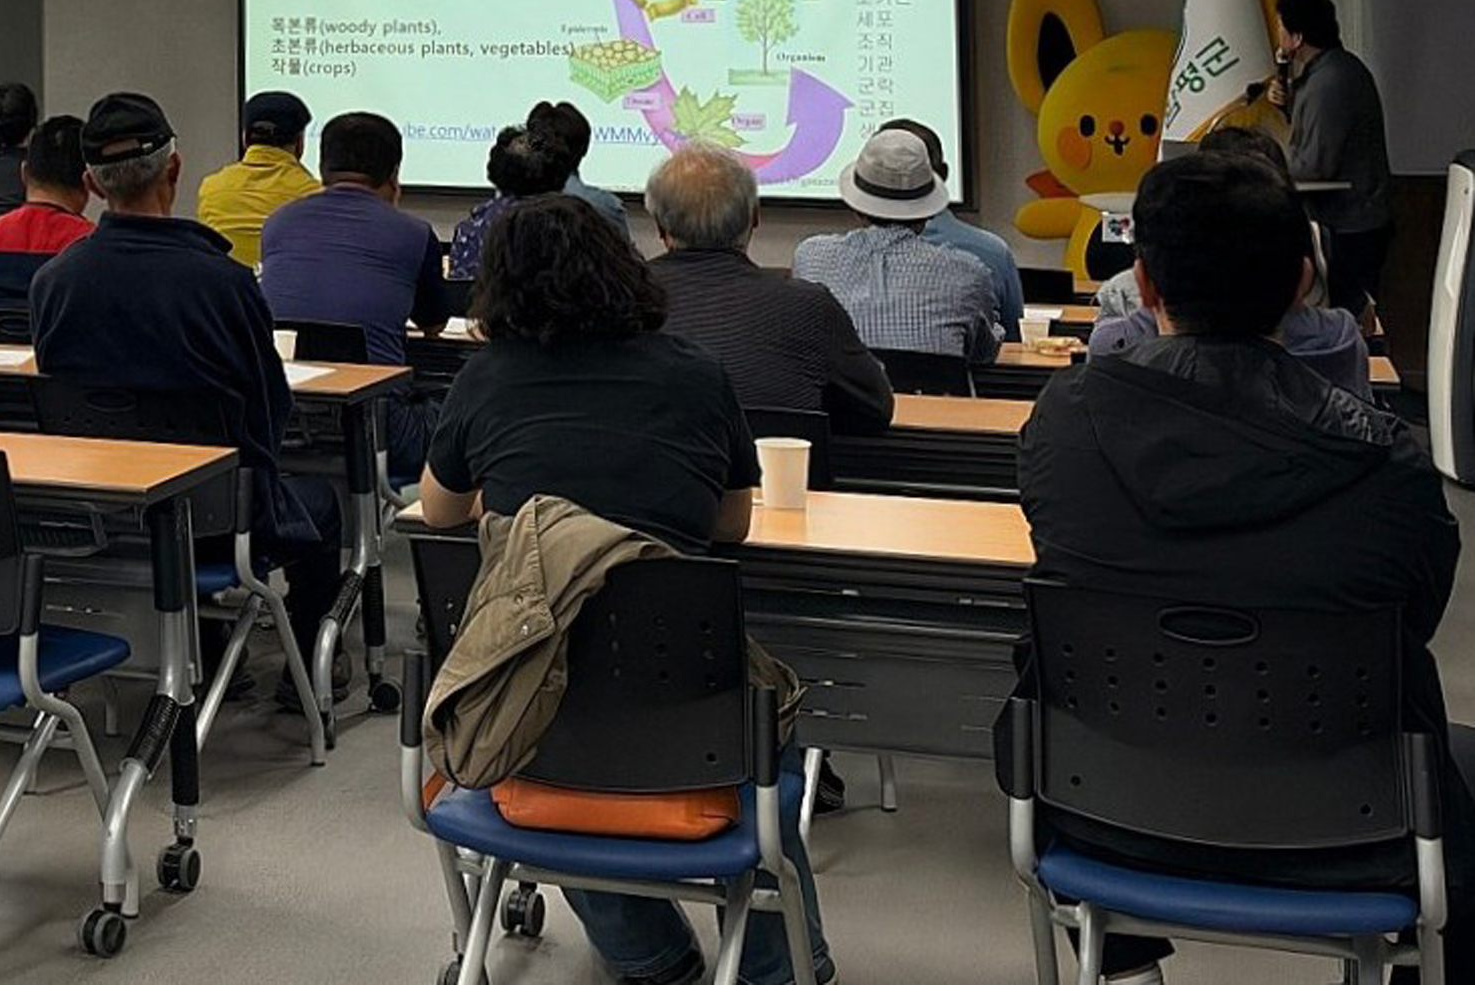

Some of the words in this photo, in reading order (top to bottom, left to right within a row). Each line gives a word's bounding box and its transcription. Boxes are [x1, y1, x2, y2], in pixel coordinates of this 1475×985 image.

[382, 18, 443, 38] plants),
[271, 36, 415, 57] 초본류(herbaceous
[420, 39, 475, 58] plants,
[480, 38, 577, 58] vegetables)
[271, 57, 357, 77] 작물(crops)
